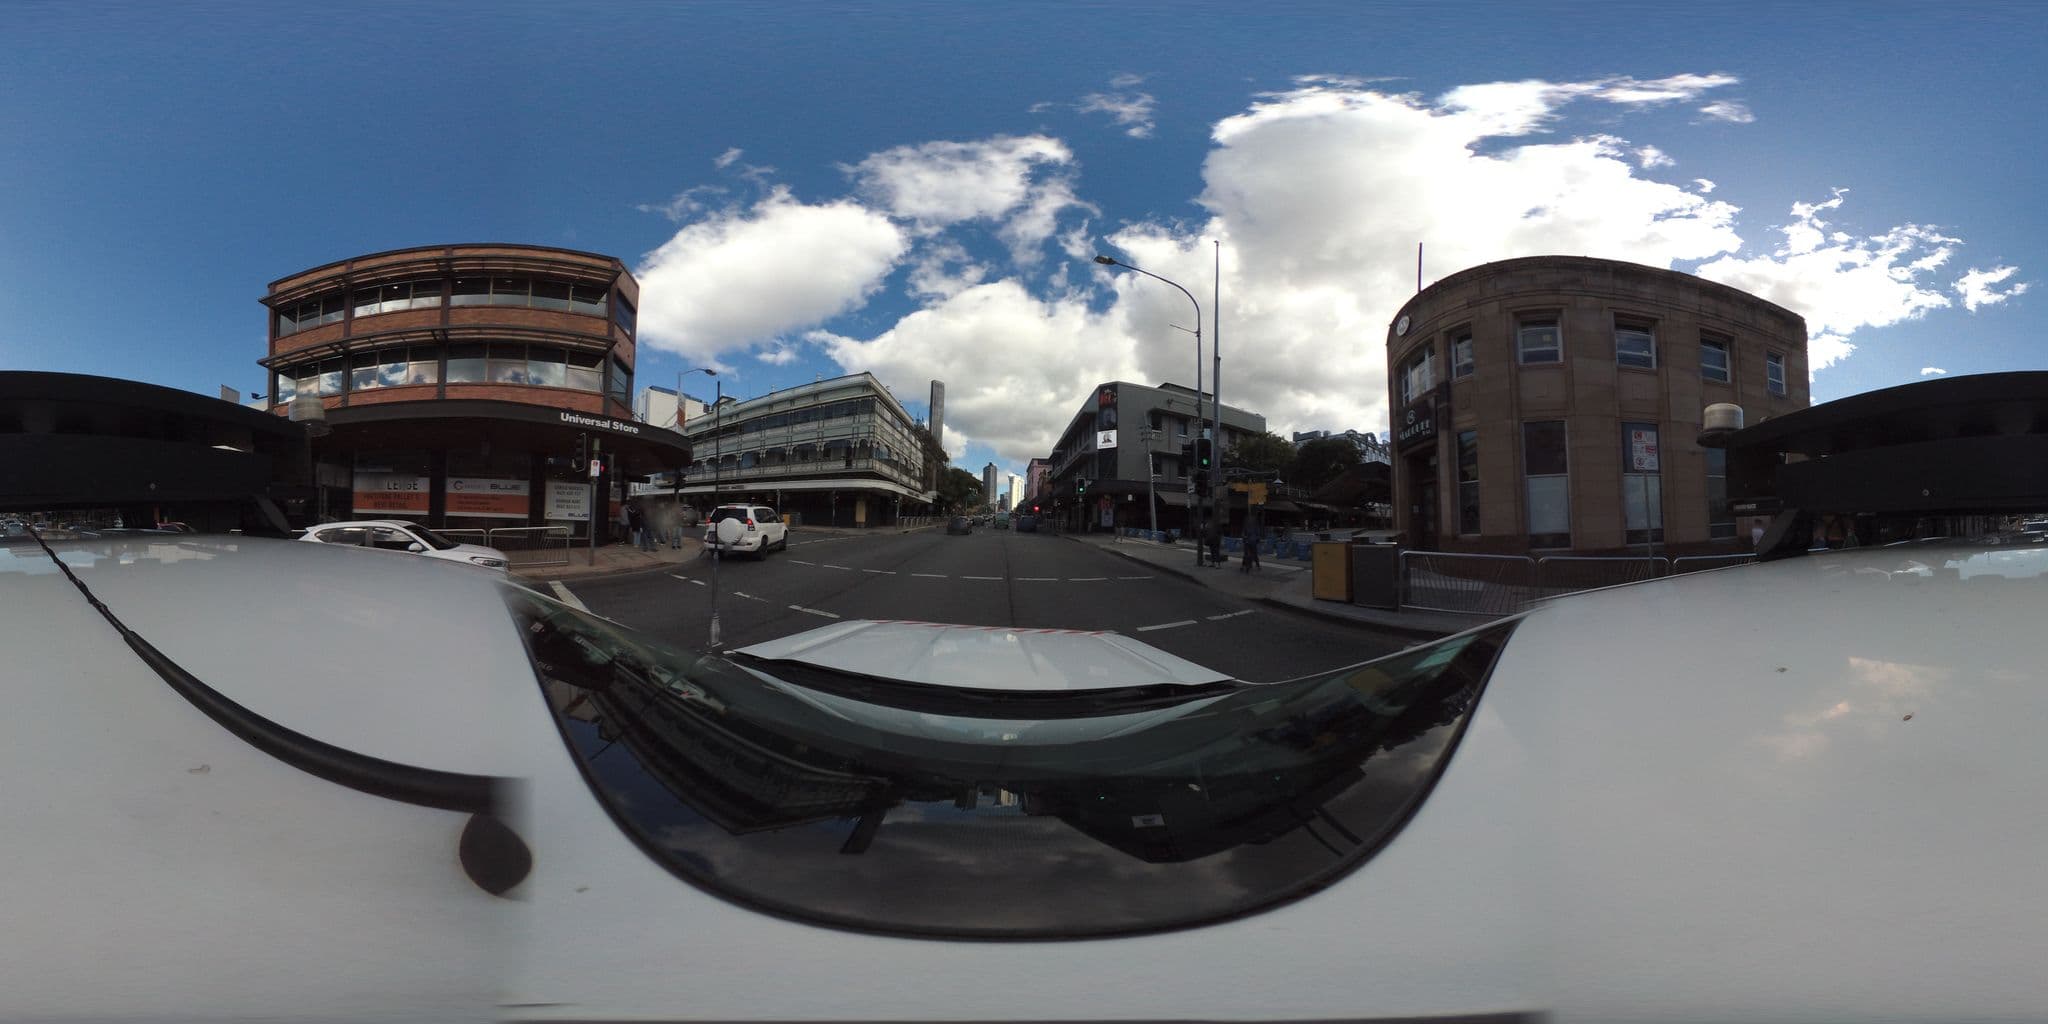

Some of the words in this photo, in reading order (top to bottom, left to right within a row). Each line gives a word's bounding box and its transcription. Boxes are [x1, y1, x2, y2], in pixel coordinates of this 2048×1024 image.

[560, 412, 610, 429] Universal
[612, 421, 639, 434] Store
[387, 481, 418, 490] LESE
